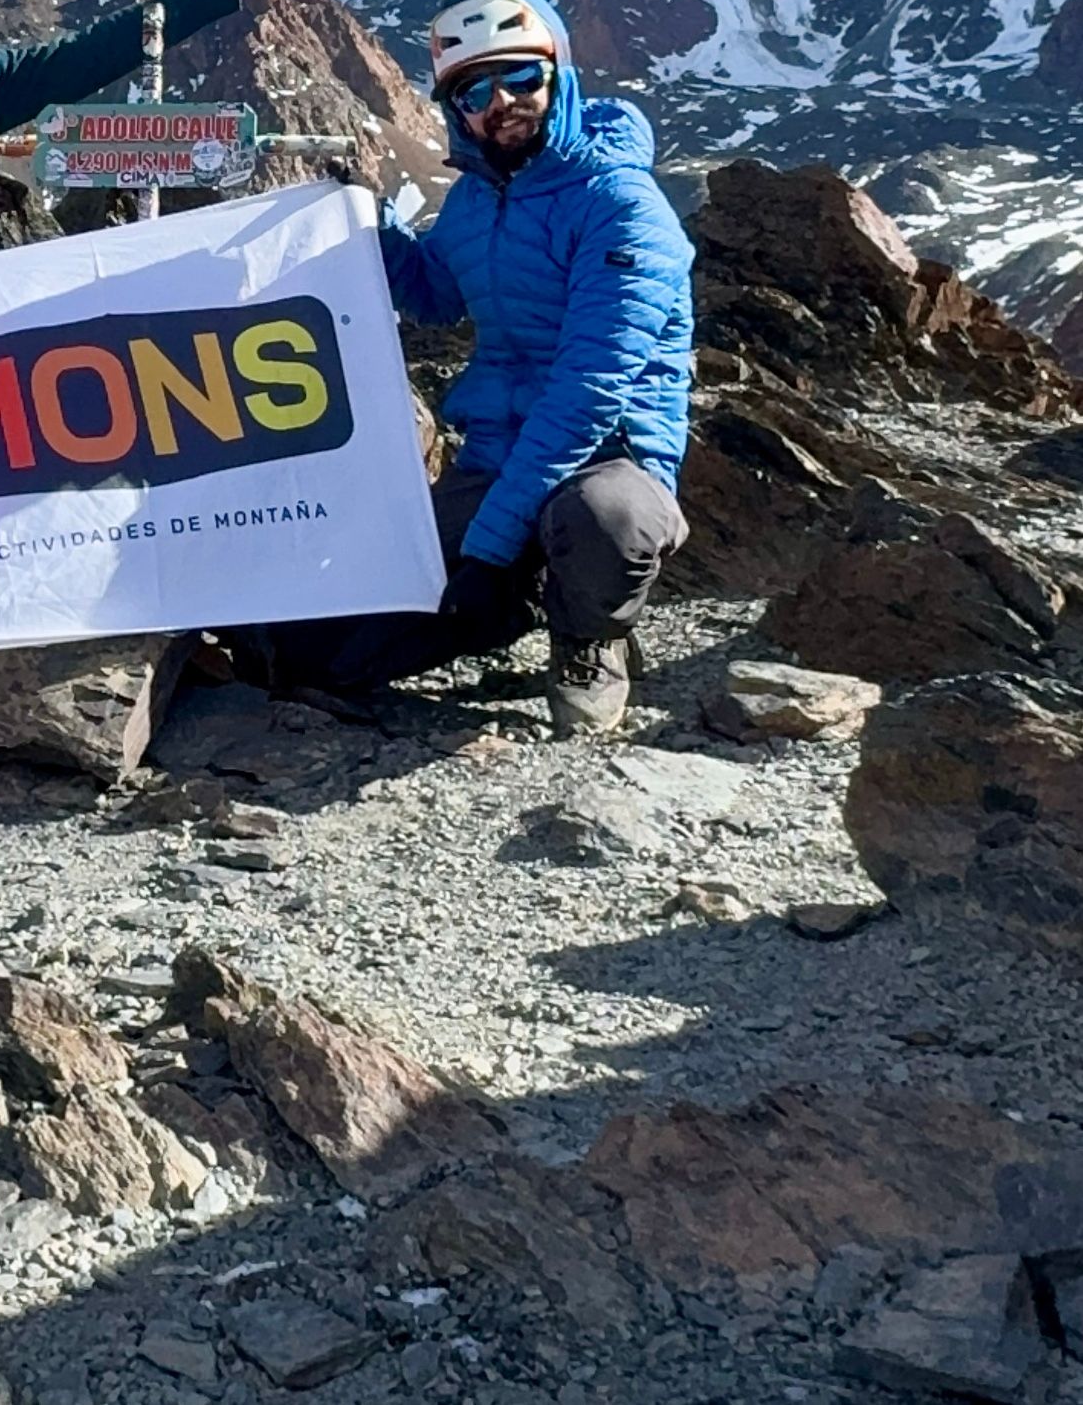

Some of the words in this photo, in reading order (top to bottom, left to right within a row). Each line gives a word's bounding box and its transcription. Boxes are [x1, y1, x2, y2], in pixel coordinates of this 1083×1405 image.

[80, 115, 167, 141] ADOLFO
[171, 115, 238, 141] CALLE
[171, 515, 202, 535] DE
[214, 499, 329, 530] MONTAÑA
